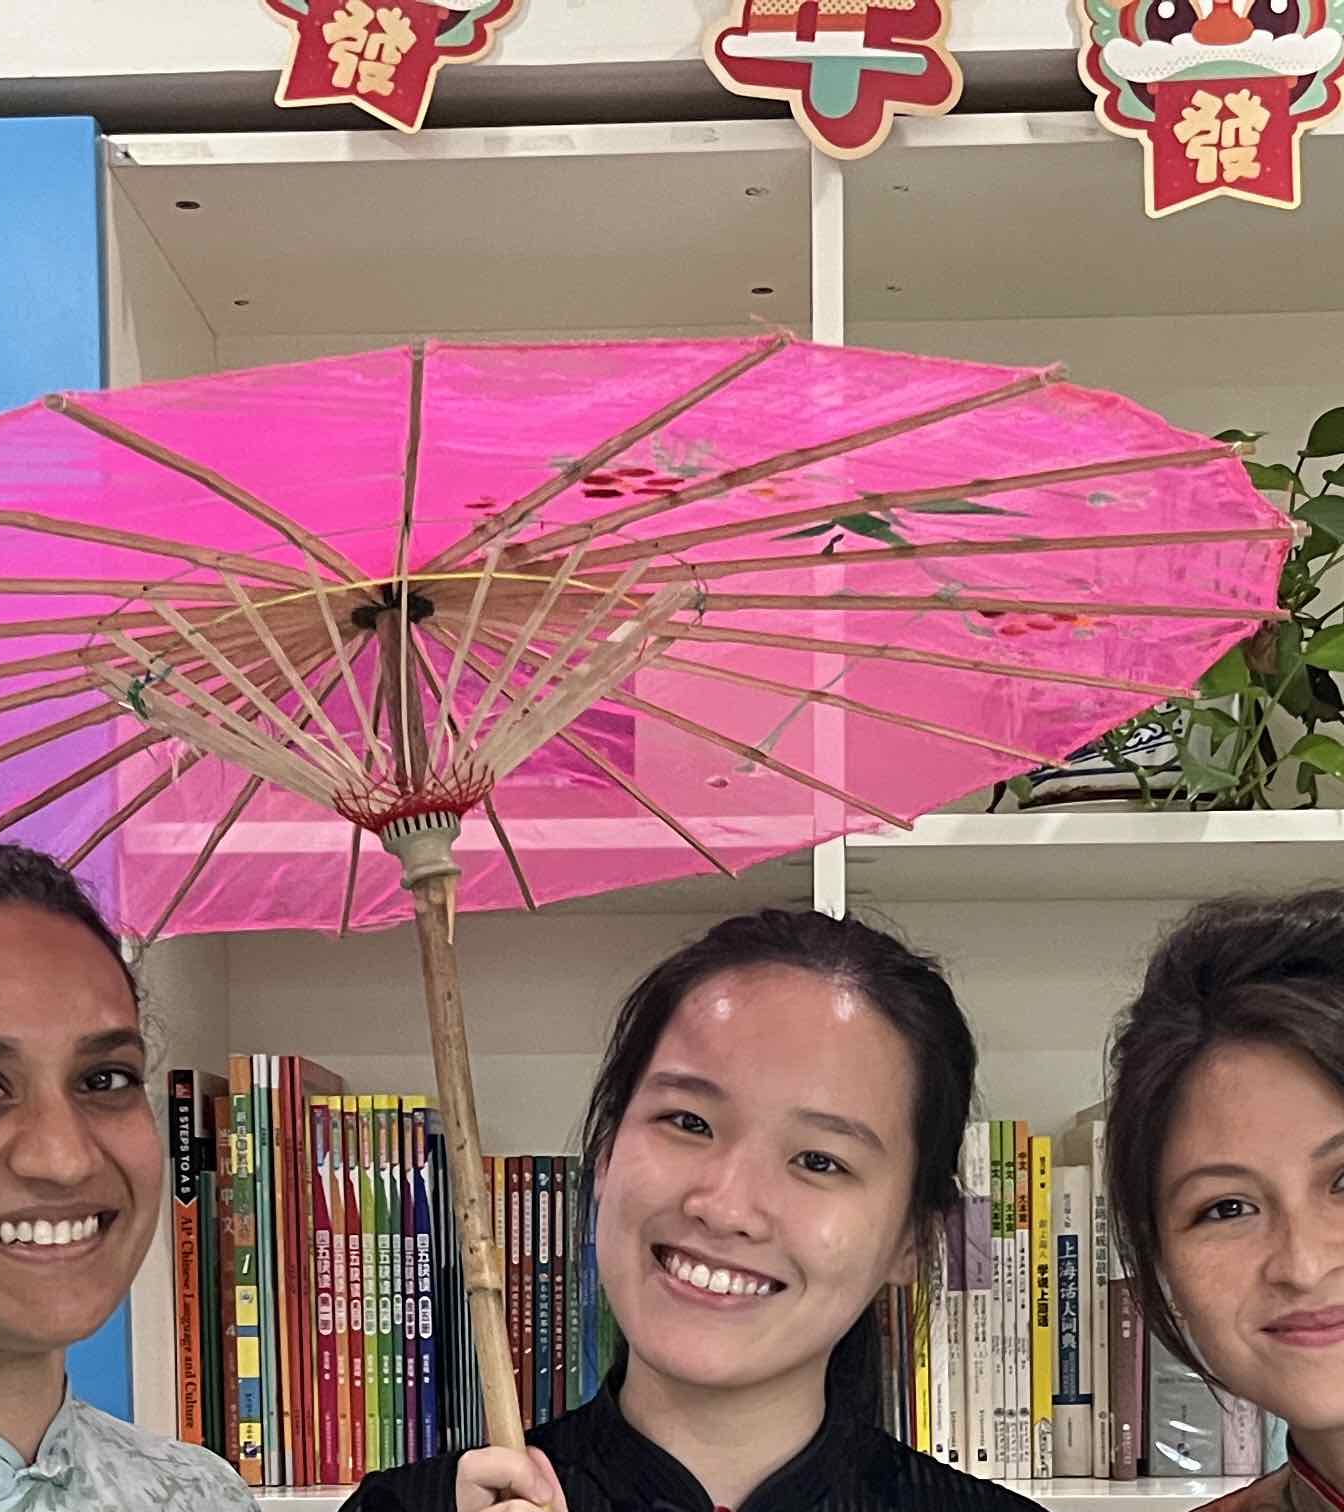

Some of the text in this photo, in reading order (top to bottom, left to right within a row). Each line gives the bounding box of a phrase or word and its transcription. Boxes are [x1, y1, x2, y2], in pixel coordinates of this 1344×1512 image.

[1173, 89, 1270, 183] 發
[179, 1116, 190, 1152] STEPS
[180, 1155, 191, 1171] TO
[181, 1174, 191, 1183] A
[181, 1216, 193, 1236] AP
[181, 1240, 194, 1289] Chinese
[184, 1356, 196, 1379] and
[185, 1382, 197, 1428] Culture
